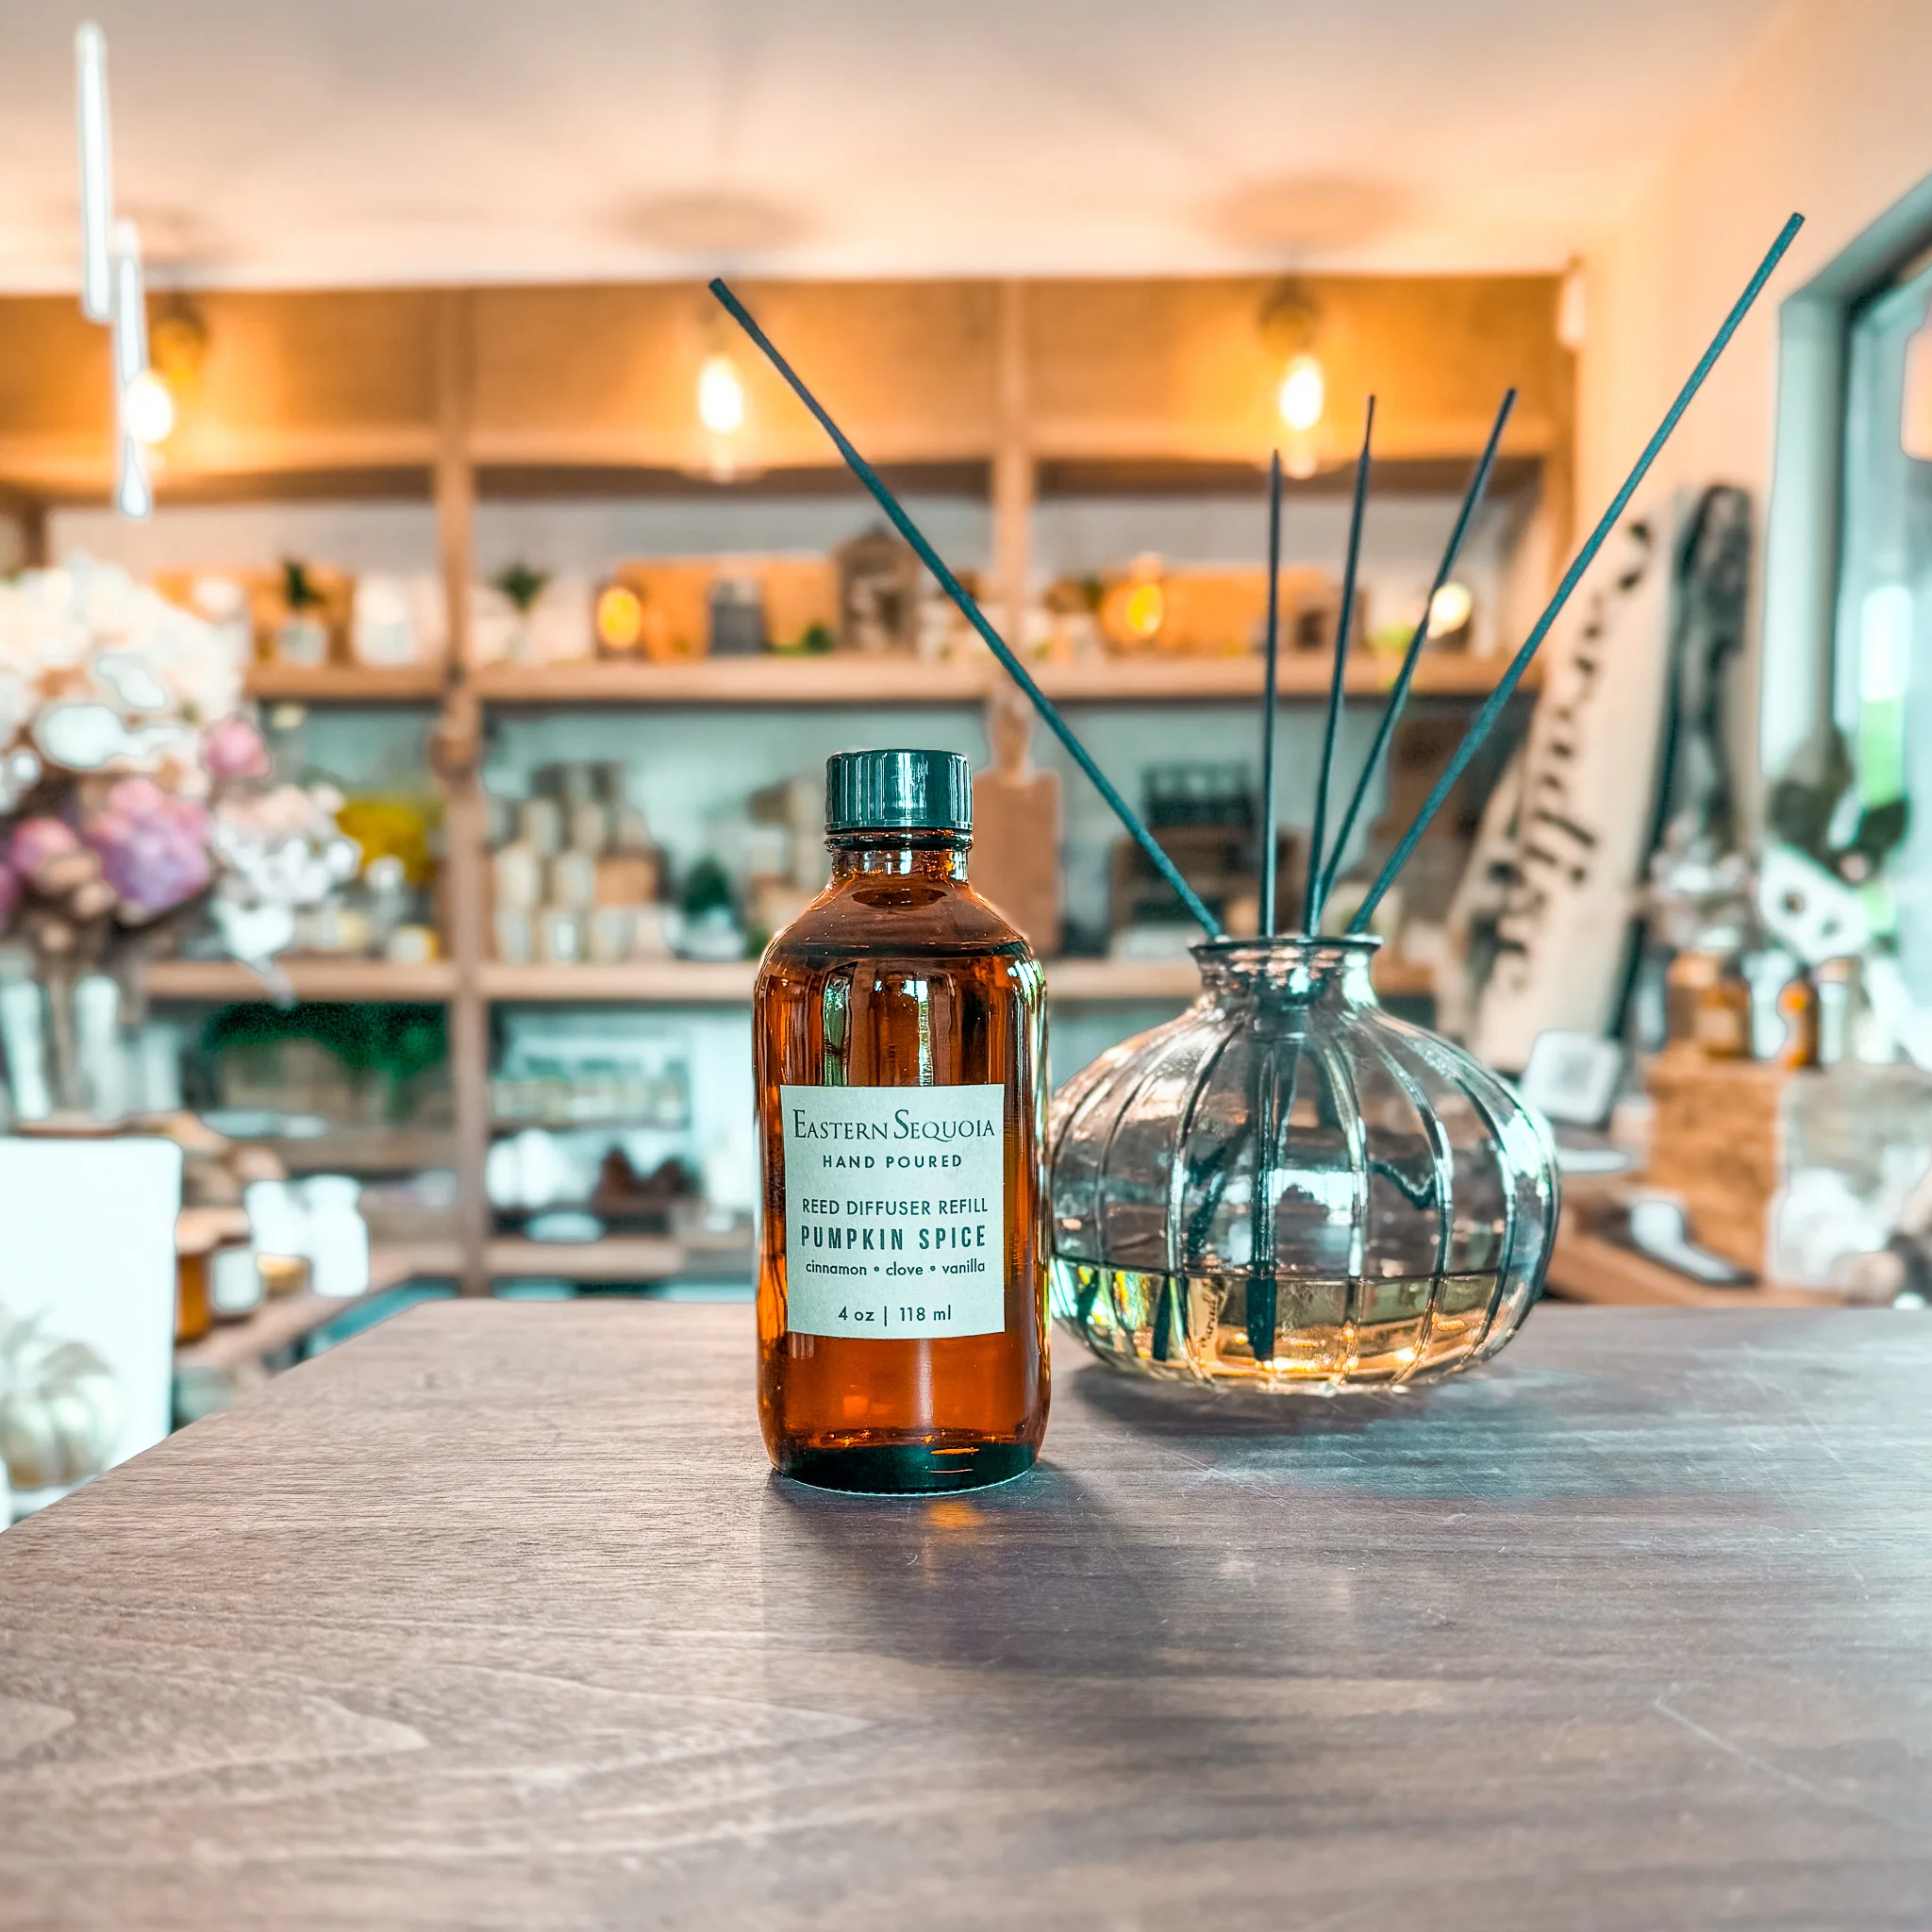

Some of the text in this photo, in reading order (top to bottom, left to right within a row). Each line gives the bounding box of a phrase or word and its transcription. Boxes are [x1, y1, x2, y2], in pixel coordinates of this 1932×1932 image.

[792, 1109, 995, 1142] EASTERN SEQUOIA
[823, 1155, 962, 1169] HAND POURED
[802, 1198, 988, 1215] REED DIFFUSER REFILL
[801, 1225, 986, 1250] PUMPKIN SPICE
[806, 1258, 986, 1275] cinnamon clove vanilla
[838, 1306, 848, 1321] 4
[854, 1310, 875, 1322] oz
[899, 1307, 926, 1322] 118
[933, 1305, 952, 1321] ml
